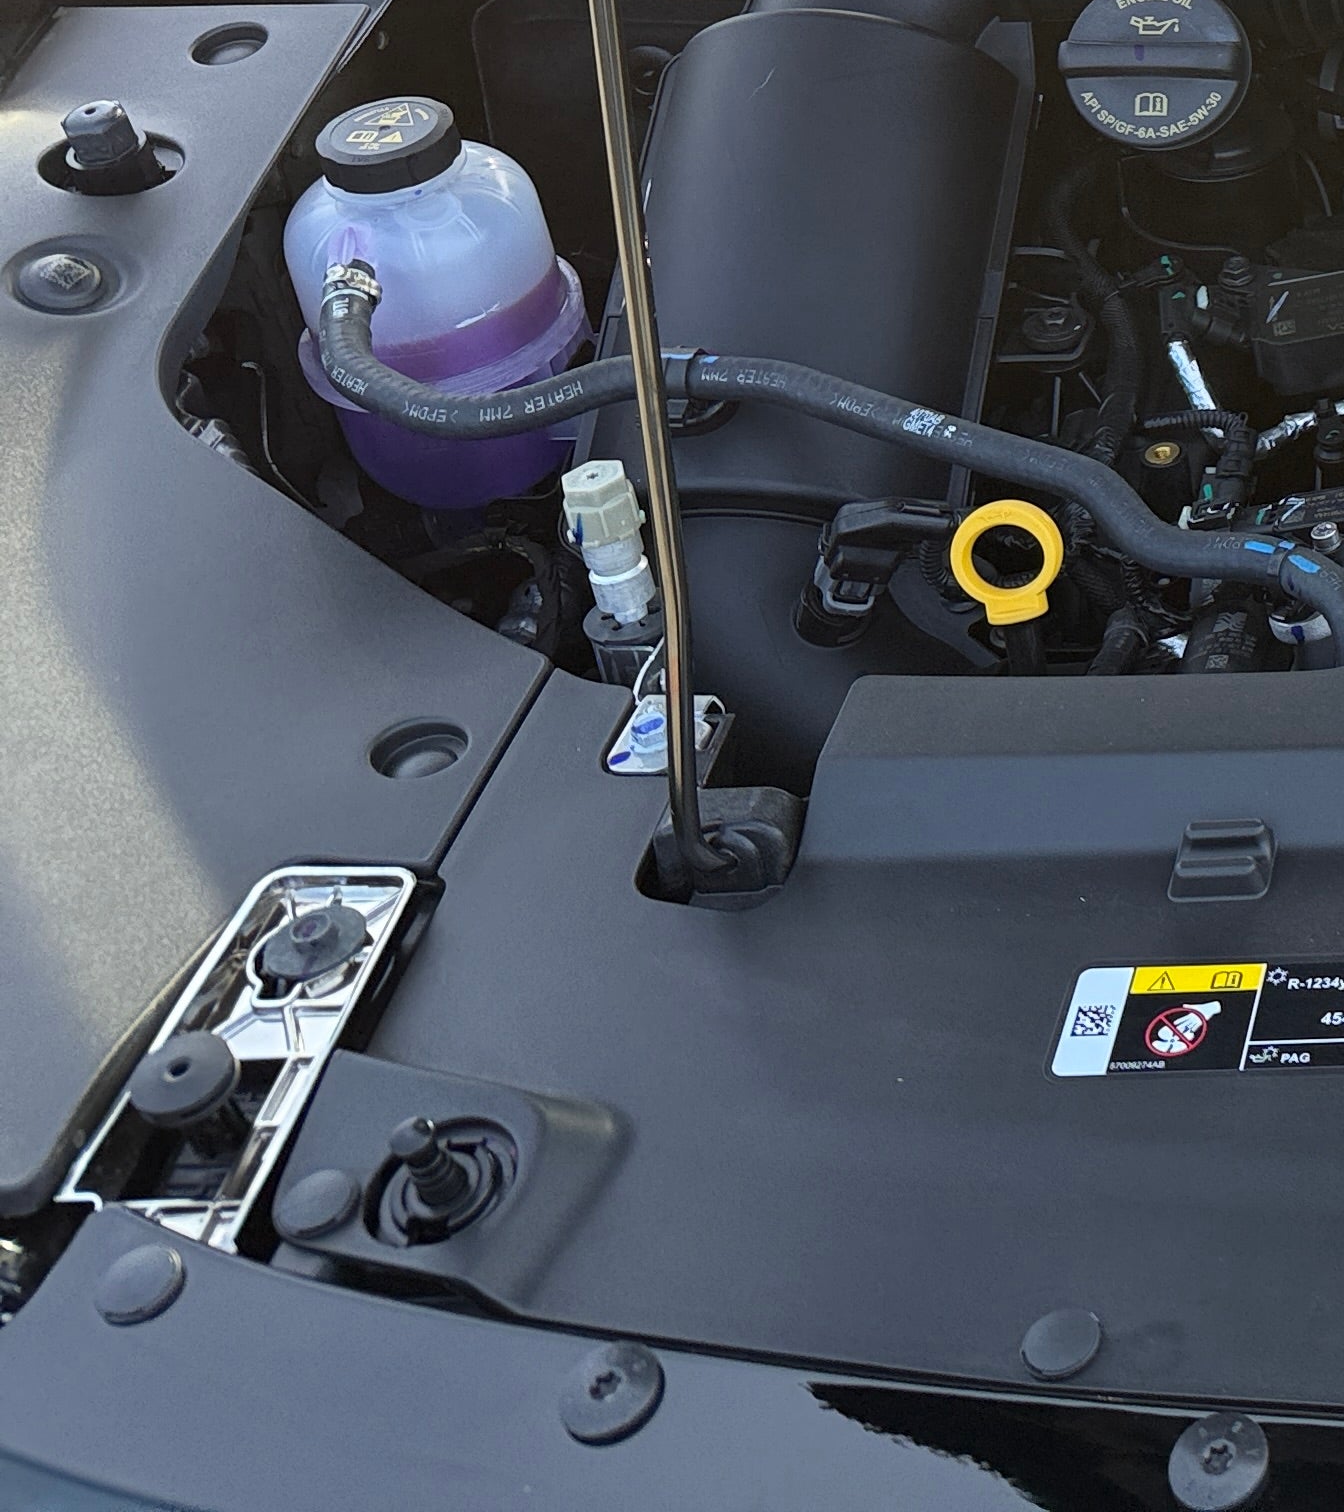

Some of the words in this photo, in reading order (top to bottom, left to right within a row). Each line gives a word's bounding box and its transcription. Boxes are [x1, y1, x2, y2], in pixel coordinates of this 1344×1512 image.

[1081, 92, 1098, 113] API
[331, 366, 369, 396] HEATER
[701, 367, 728, 383] 7MM
[736, 369, 788, 390] HEATER
[524, 380, 584, 415] HEATER
[479, 405, 514, 423] 7MM
[1279, 1051, 1311, 1065] PAG
